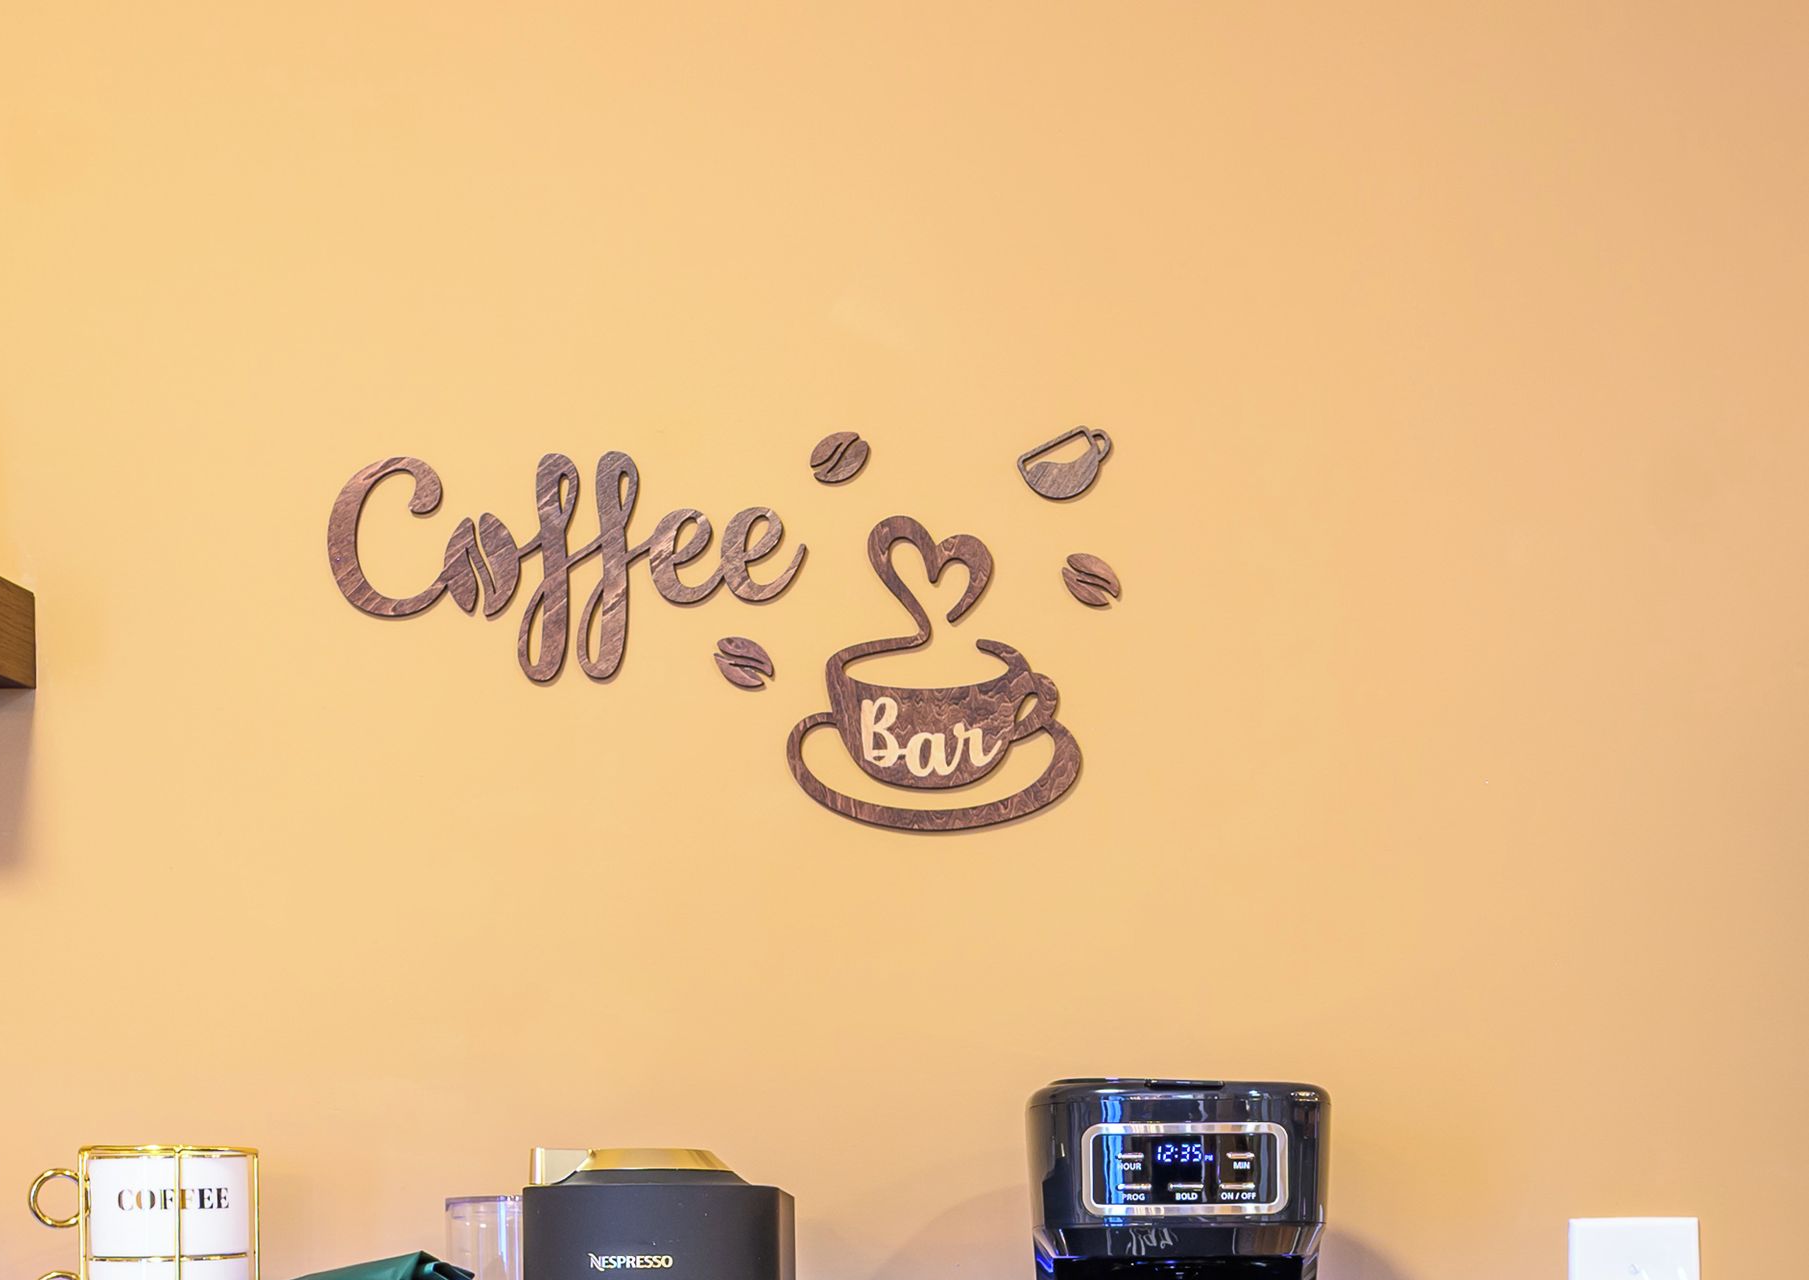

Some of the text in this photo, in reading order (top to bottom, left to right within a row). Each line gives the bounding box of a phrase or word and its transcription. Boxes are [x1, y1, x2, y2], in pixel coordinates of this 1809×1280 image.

[327, 450, 808, 682] Coffee
[860, 695, 1005, 778] Bar
[1157, 1144, 1202, 1162] 12:35
[1118, 1162, 1142, 1171] HOUR
[1233, 1162, 1251, 1170] MIN
[117, 1187, 230, 1211] COFFEE
[1122, 1193, 1145, 1201] PROG
[1175, 1193, 1198, 1201] BOLD
[588, 1253, 674, 1272] NESPRESSO
